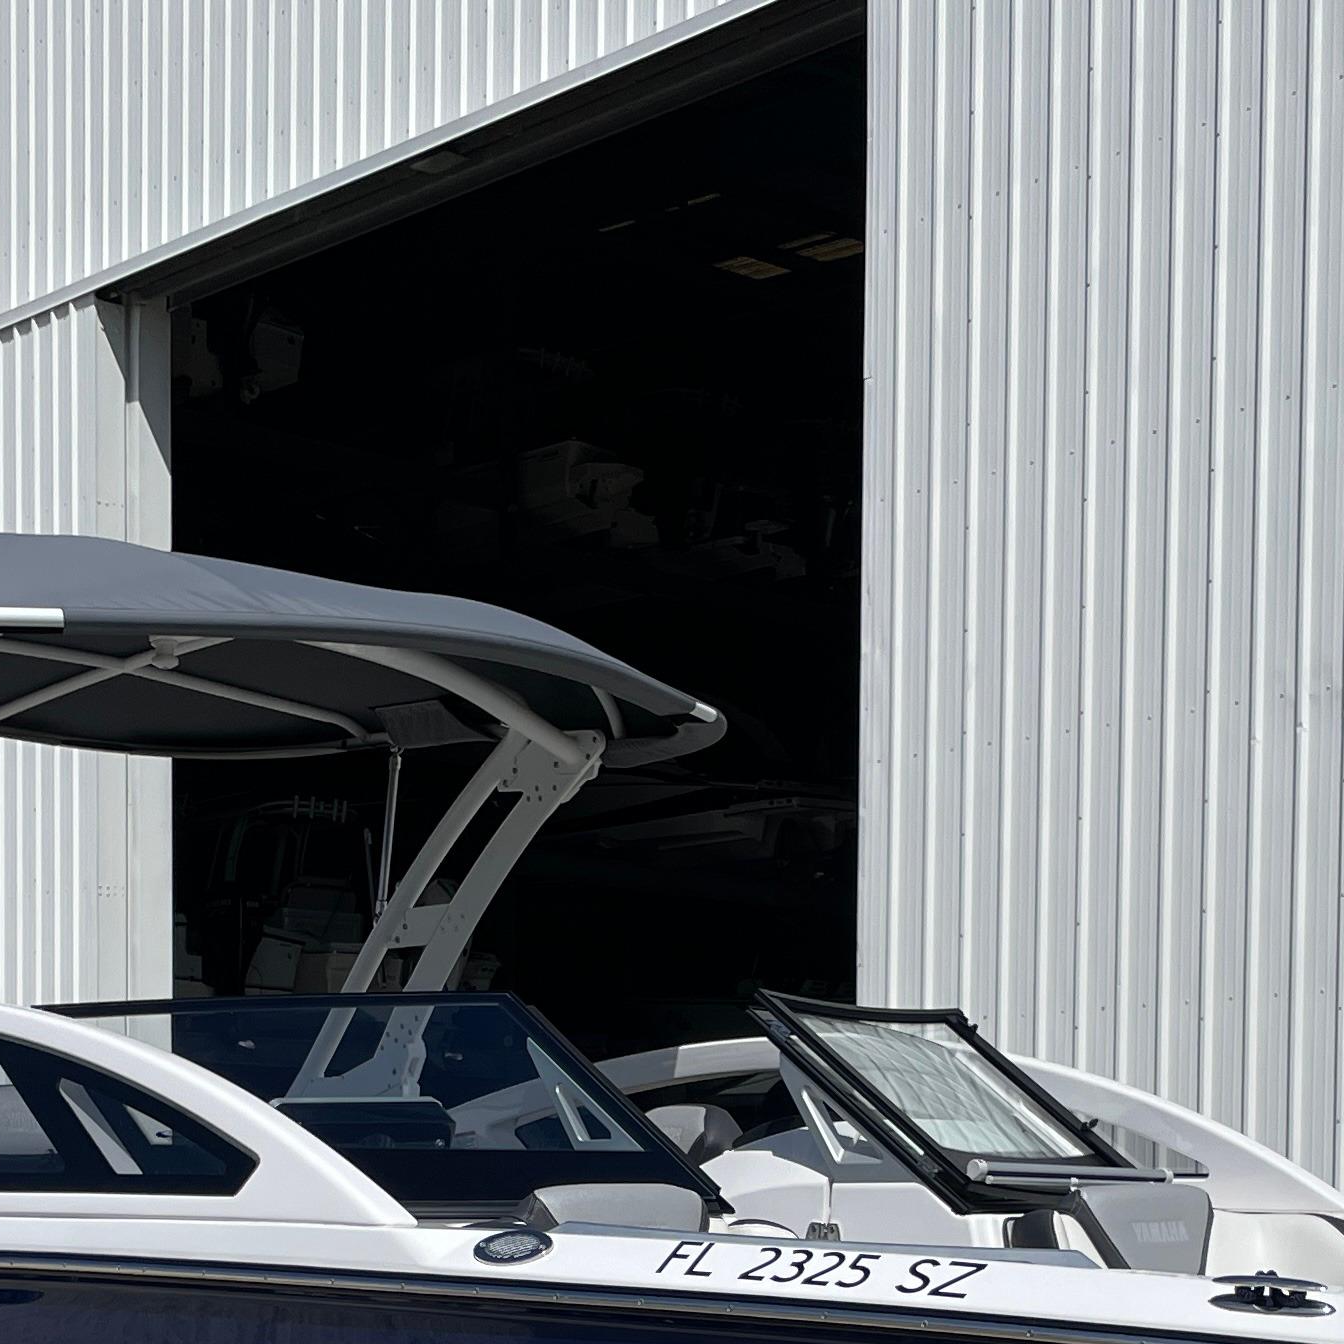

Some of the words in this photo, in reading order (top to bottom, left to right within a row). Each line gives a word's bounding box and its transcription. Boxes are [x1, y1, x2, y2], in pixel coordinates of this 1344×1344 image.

[1130, 1220, 1189, 1242] YAMAHA
[655, 1240, 716, 1277] FL
[737, 1247, 882, 1288] 2325
[894, 1258, 988, 1299] SZ
